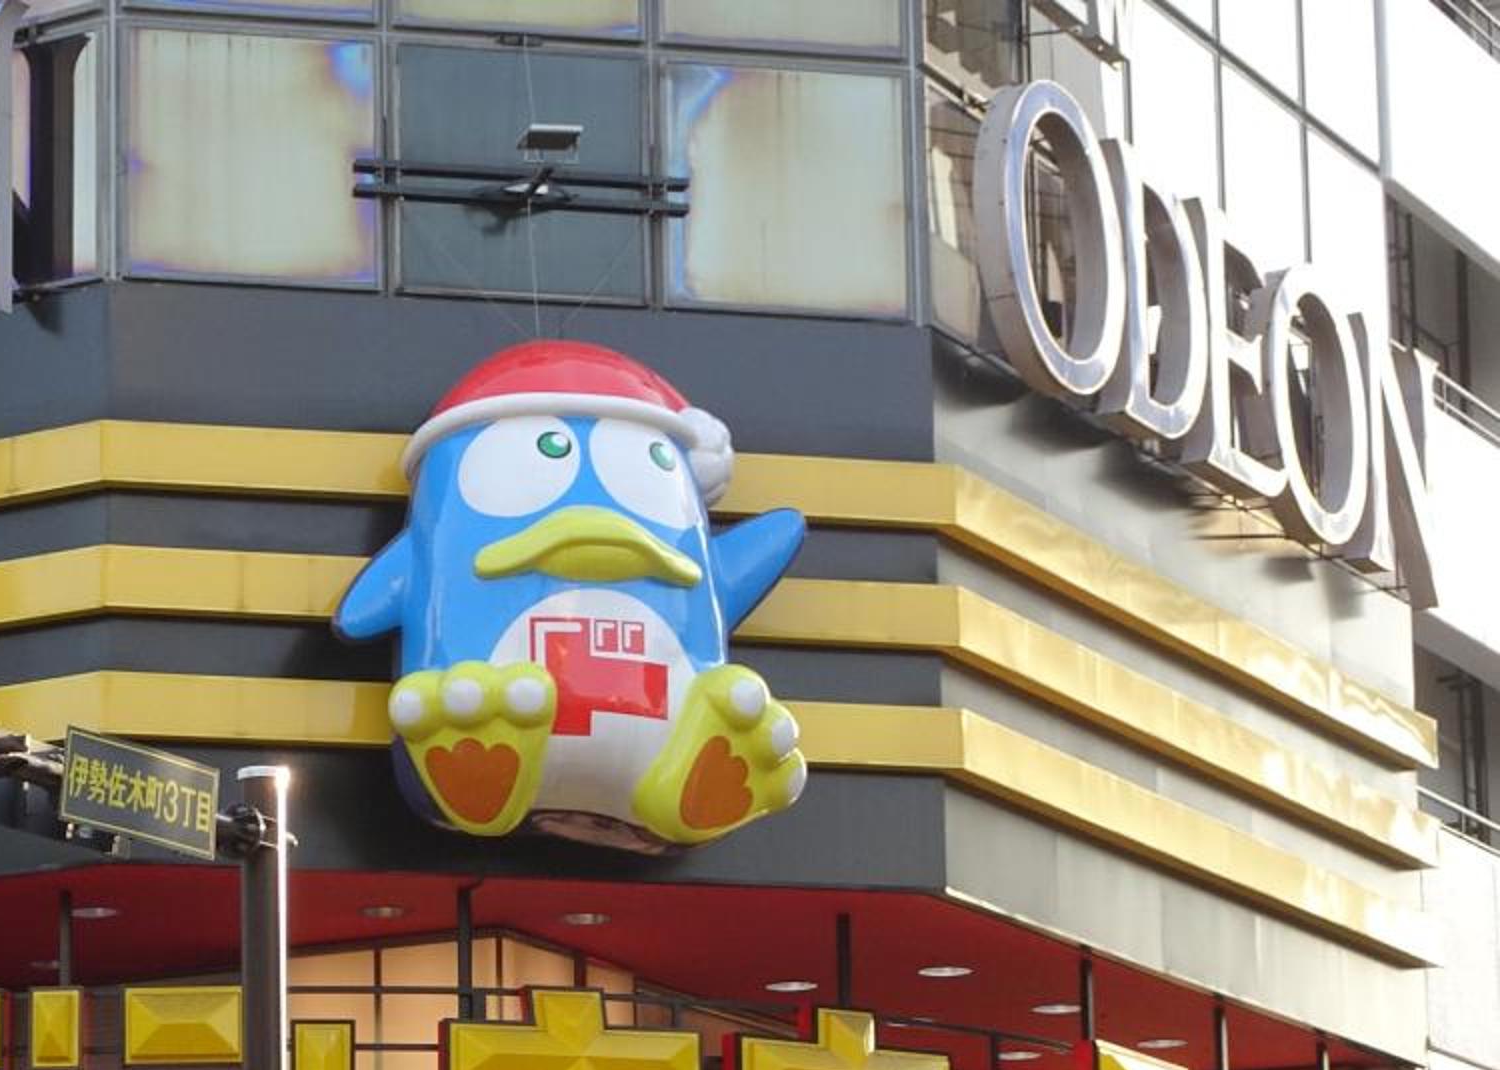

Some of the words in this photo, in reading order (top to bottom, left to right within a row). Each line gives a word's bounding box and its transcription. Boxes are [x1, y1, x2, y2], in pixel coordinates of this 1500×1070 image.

[980, 78, 1440, 607] ODEON
[68, 752, 213, 832] 伊勢佐木町3丁目
